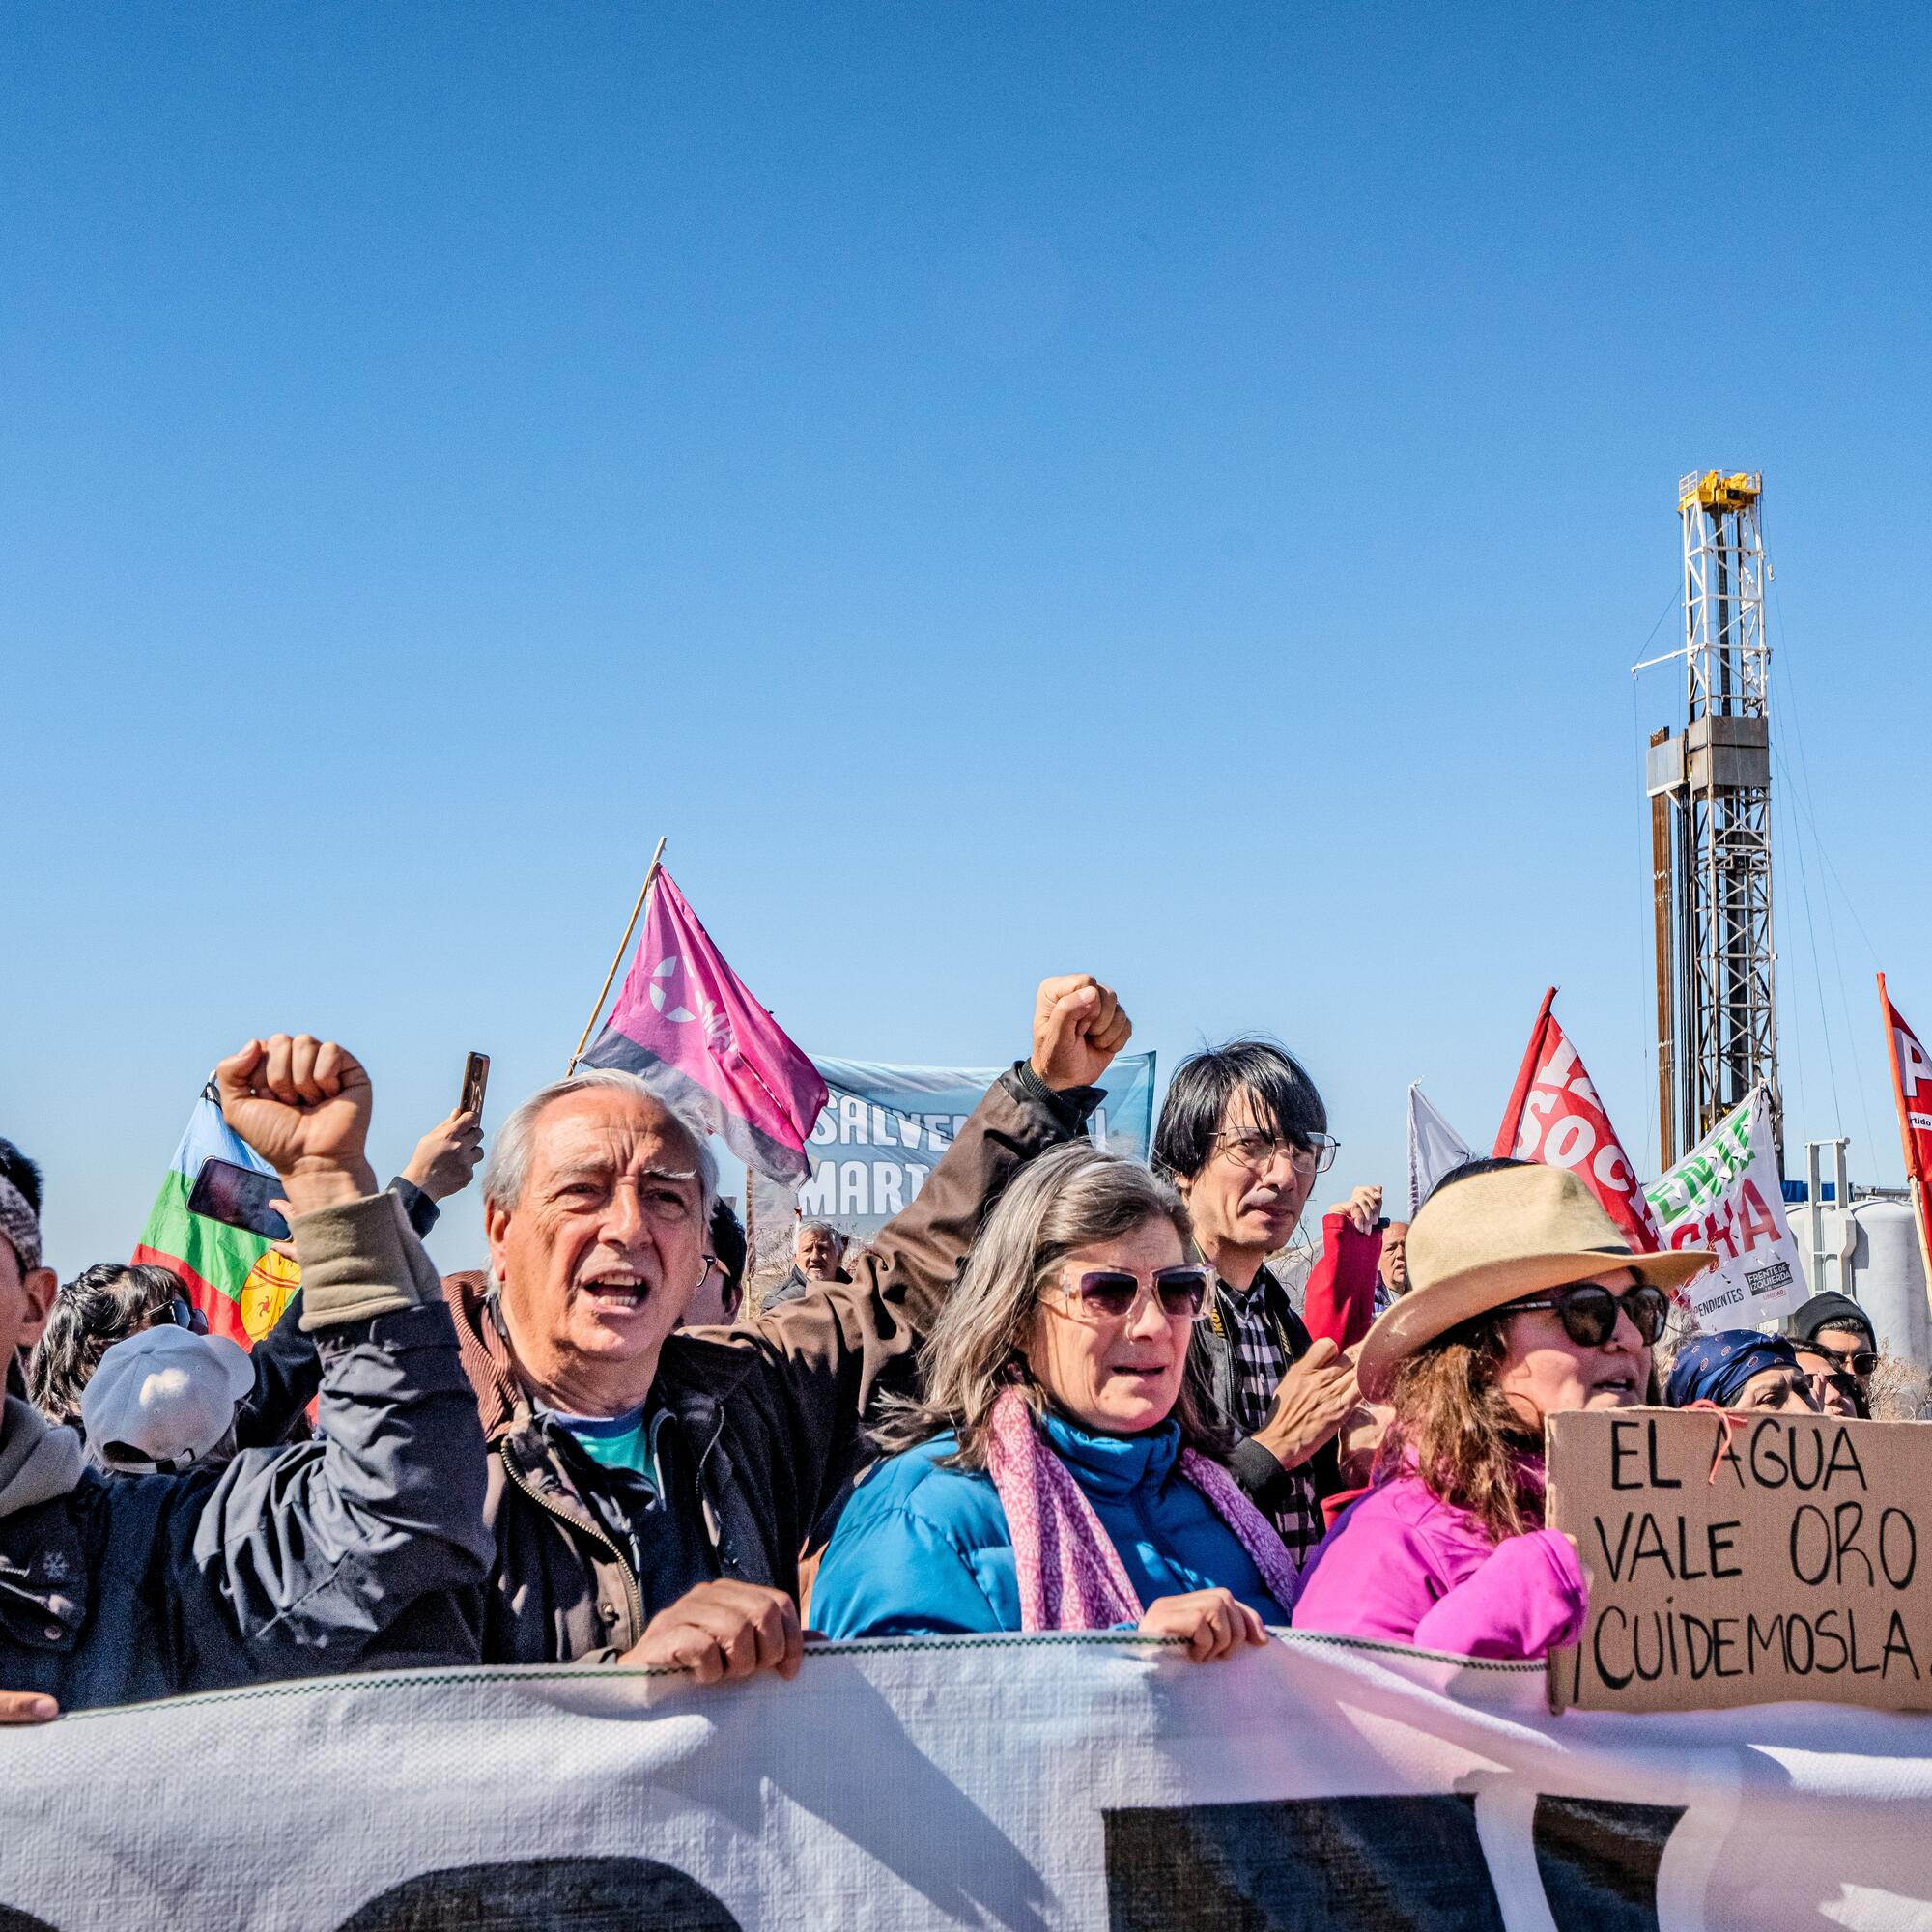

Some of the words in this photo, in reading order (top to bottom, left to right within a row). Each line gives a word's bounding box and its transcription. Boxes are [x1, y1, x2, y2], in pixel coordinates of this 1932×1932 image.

[1748, 1265, 1778, 1284] FRENTE
[1777, 1264, 1787, 1273] DE
[1749, 1270, 1791, 1292] IZQUIERDA
[1611, 1419, 1682, 1491] EL
[1710, 1417, 1868, 1491] AGUA
[1594, 1511, 1743, 1583] VALE
[1789, 1500, 1918, 1591] ORO
